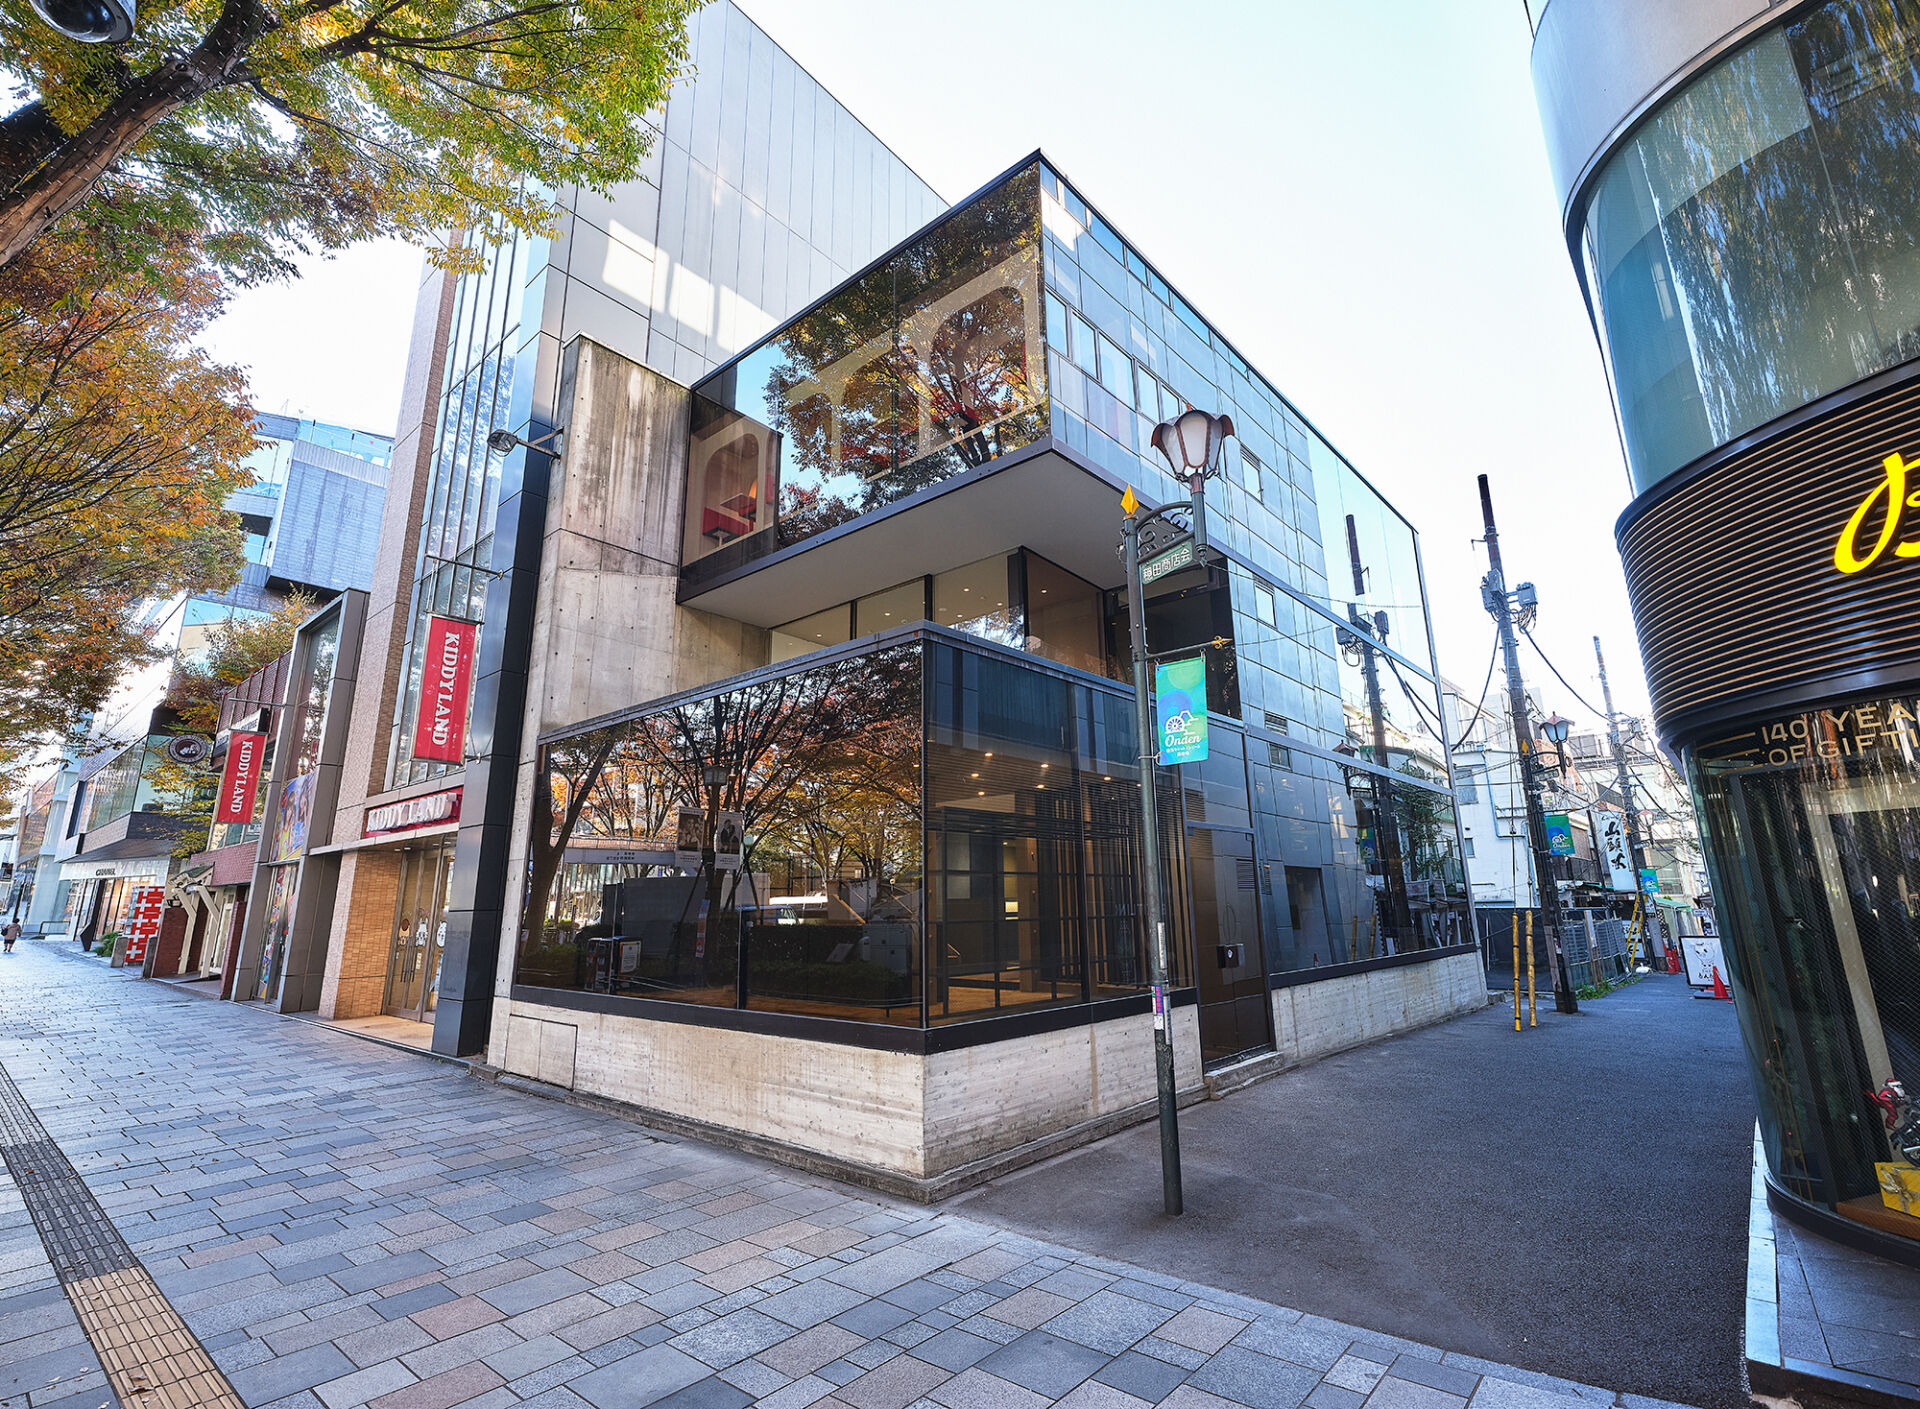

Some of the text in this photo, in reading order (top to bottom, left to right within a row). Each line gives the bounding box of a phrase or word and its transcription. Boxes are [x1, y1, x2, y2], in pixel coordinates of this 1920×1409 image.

[1762, 700, 1920, 744] 140 YEA
[1165, 734, 1201, 747] Onden
[1768, 744, 1806, 766] OF
